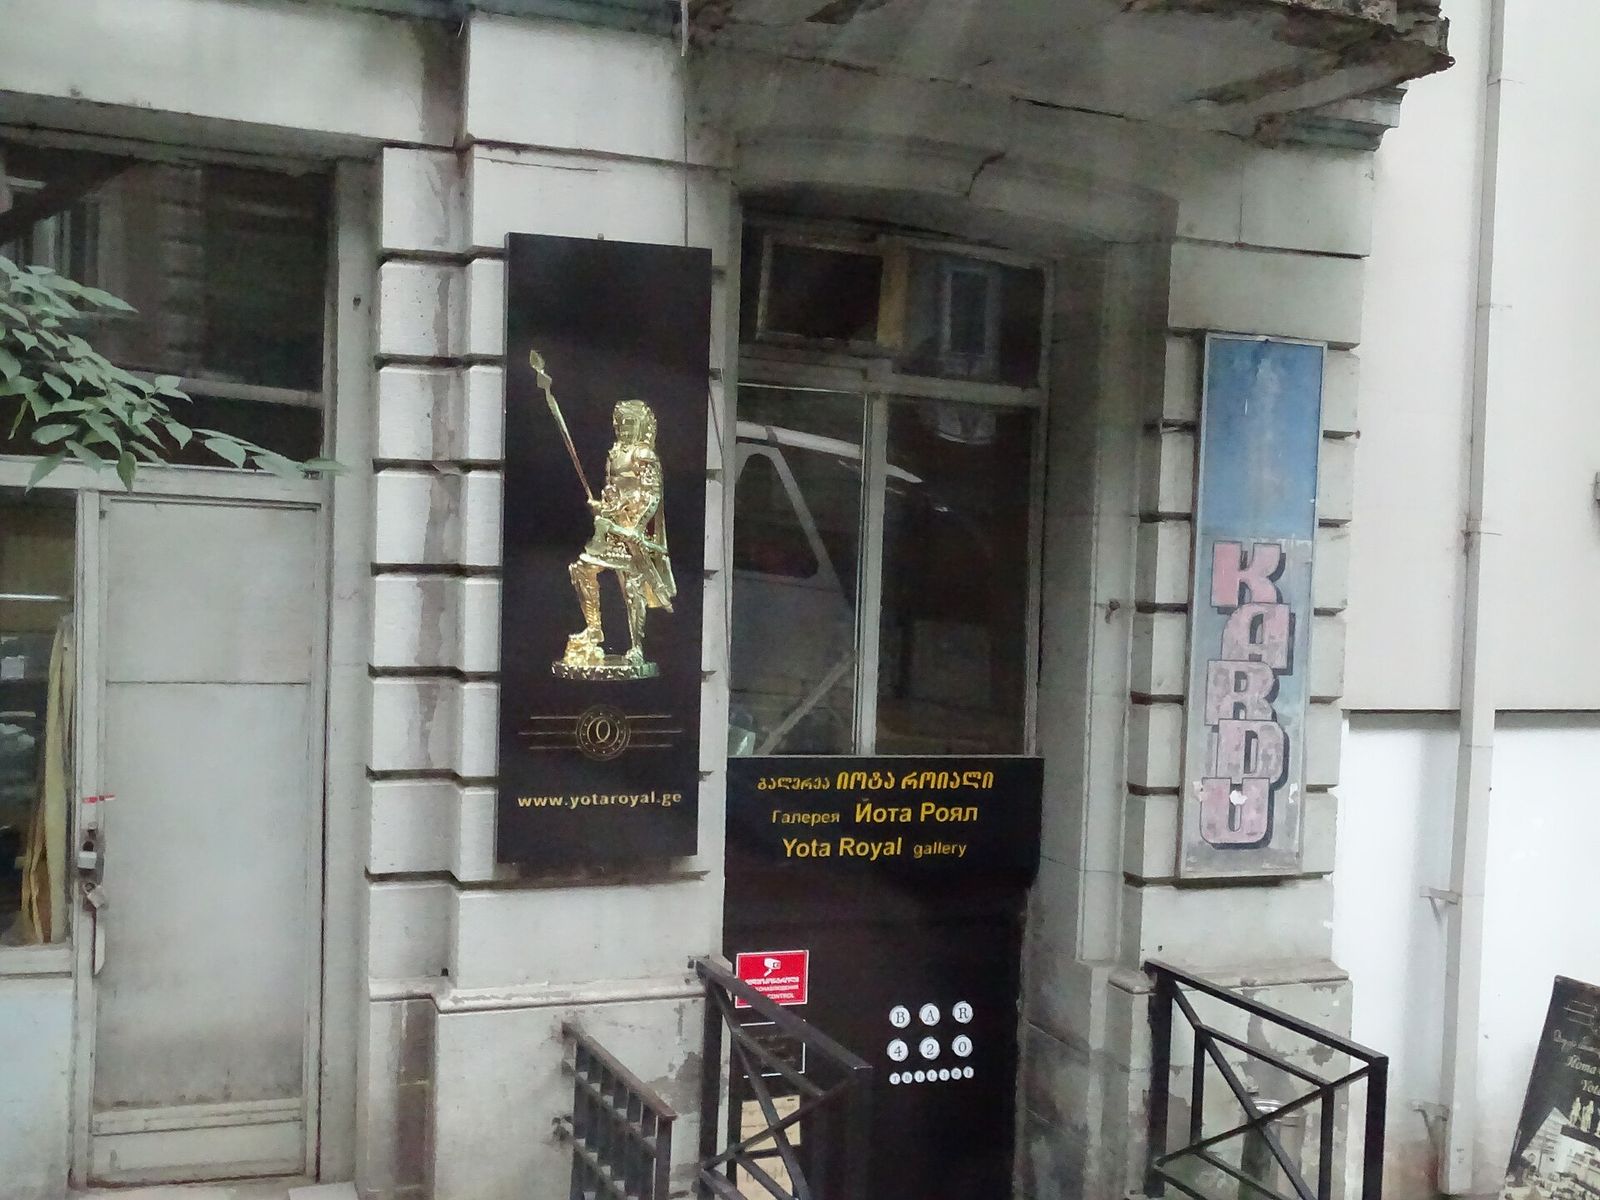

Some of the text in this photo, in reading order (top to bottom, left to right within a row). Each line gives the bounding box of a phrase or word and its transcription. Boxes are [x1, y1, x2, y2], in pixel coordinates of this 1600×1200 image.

[1200, 540, 1295, 849] KARDU
[836, 771, 896, 790] იოტა
[900, 771, 994, 790] როიალი
[517, 789, 682, 810] www.yotaroyal.ge
[771, 798, 979, 827] Галерея Йота Роял
[782, 836, 967, 861] Yota Royal gallery
[893, 1005, 971, 1026] BAR
[891, 1038, 970, 1059] 420
